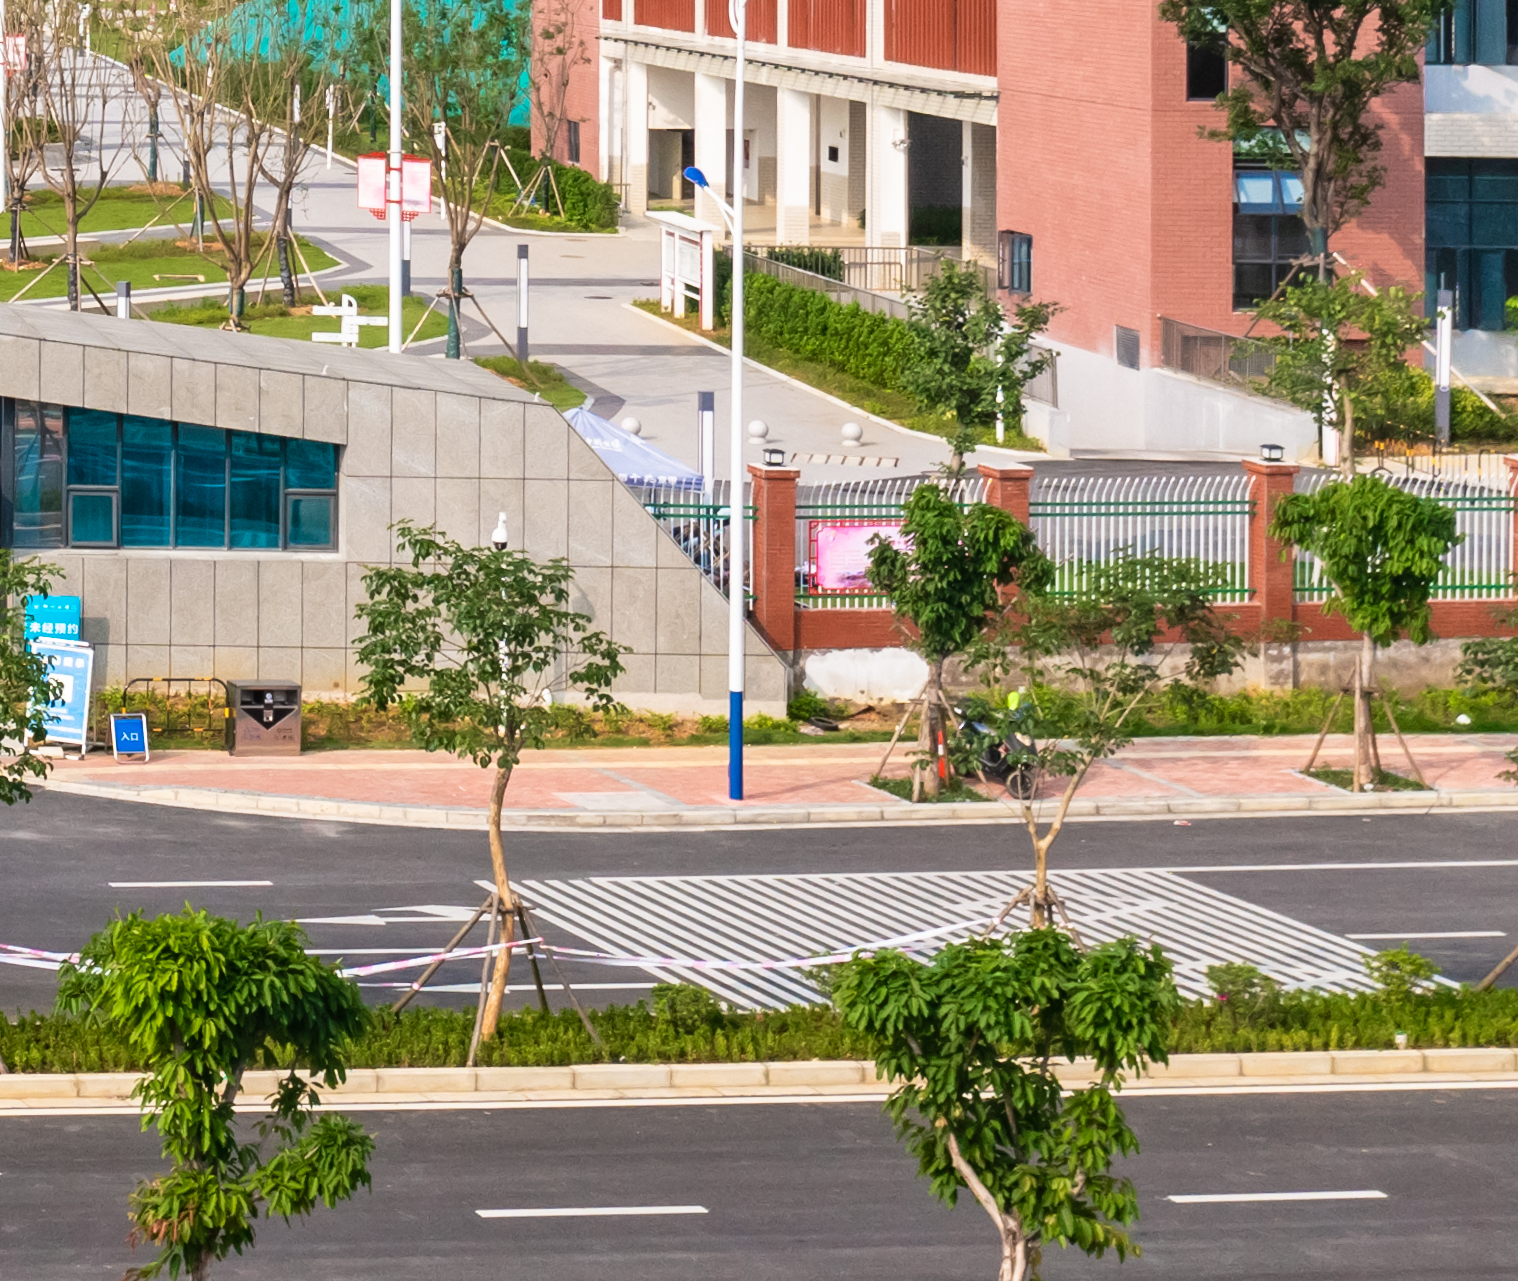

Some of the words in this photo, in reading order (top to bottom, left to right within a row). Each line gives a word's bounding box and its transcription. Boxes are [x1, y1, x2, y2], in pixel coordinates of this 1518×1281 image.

[29, 621, 79, 634] 未经预约
[121, 732, 139, 741] 入口
